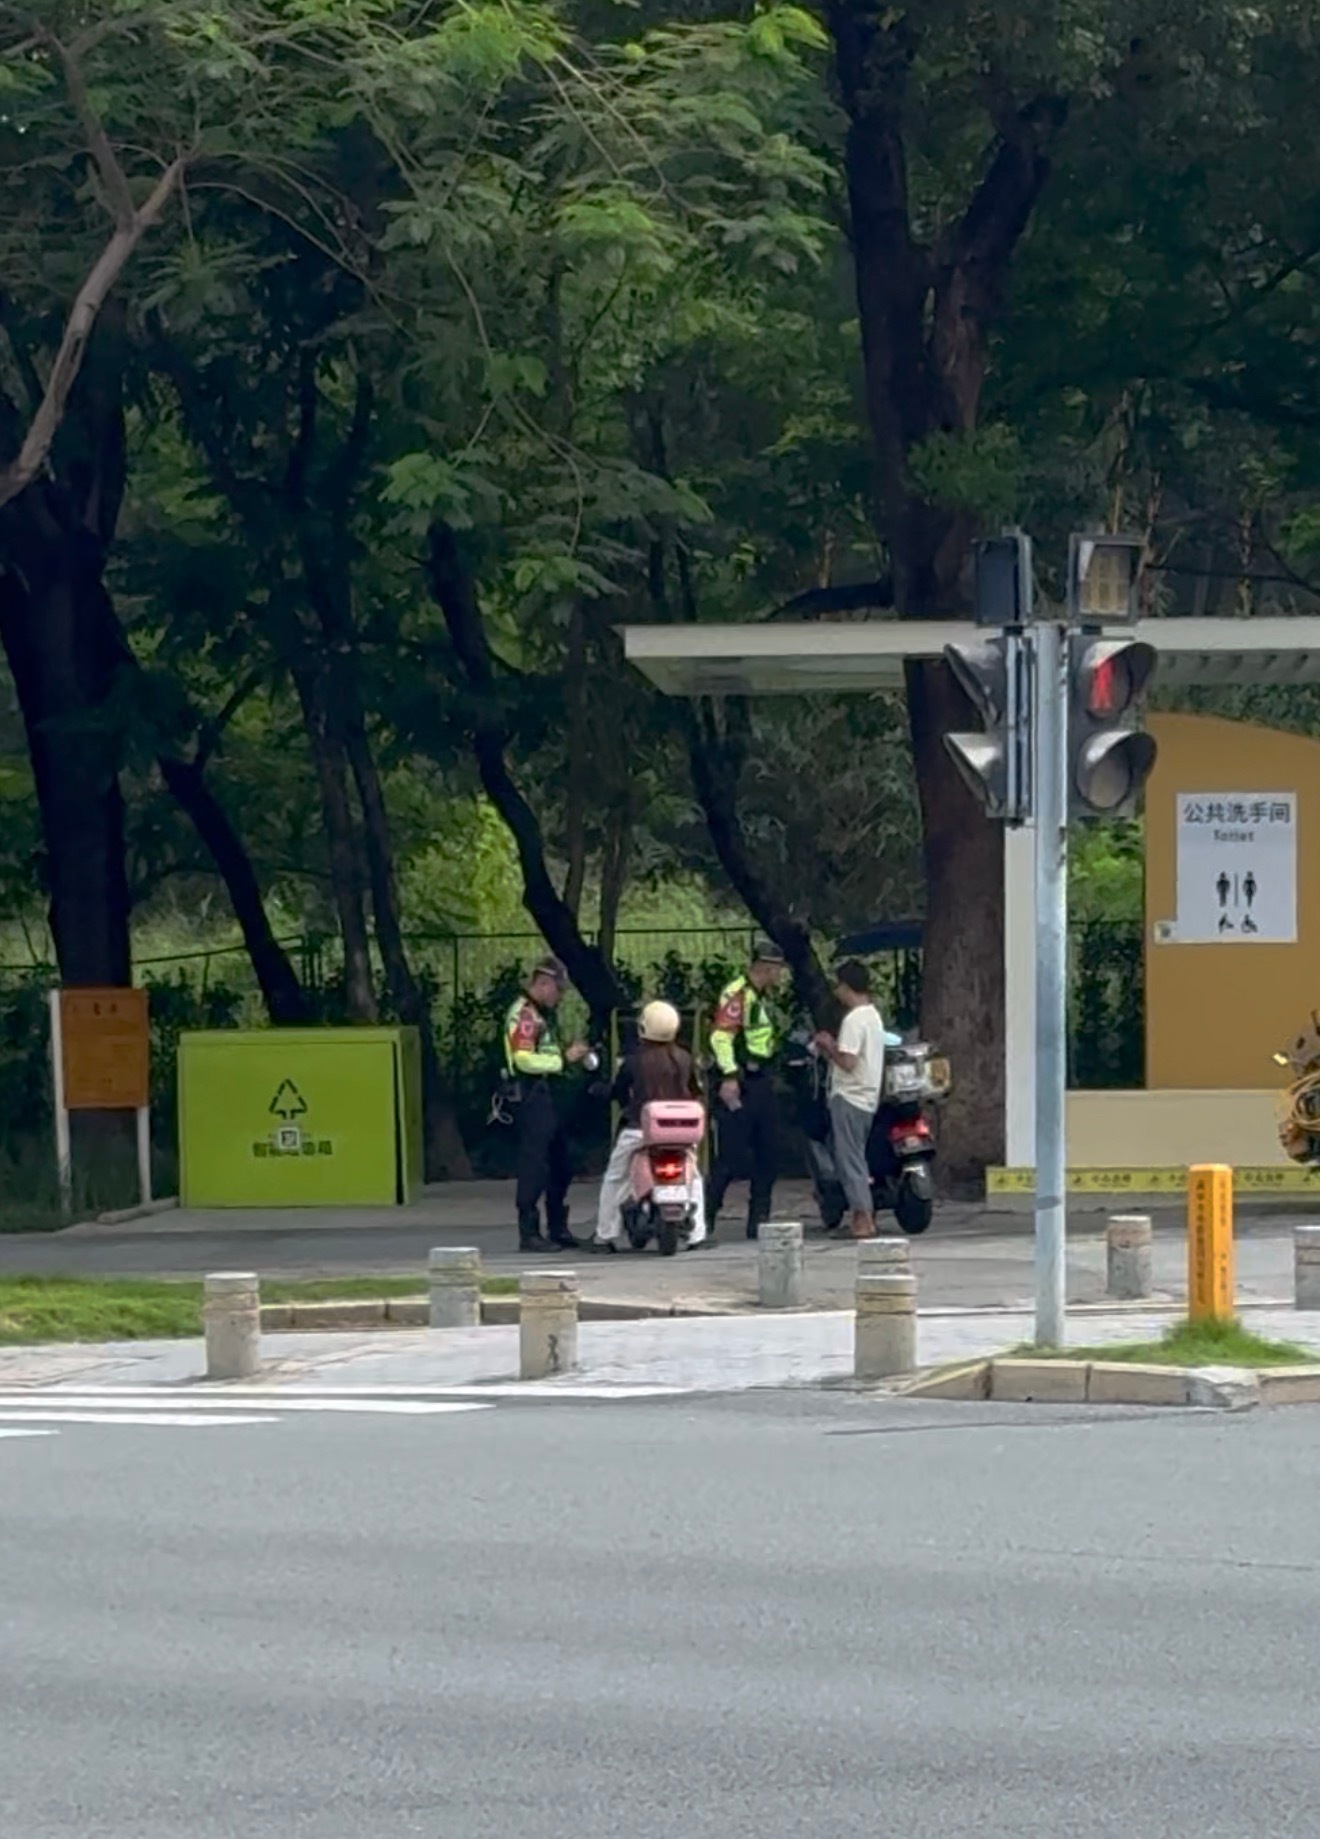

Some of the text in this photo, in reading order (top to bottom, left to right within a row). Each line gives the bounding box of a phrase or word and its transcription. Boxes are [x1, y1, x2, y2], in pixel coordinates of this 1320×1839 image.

[1184, 802, 1291, 823] 公共洗手间
